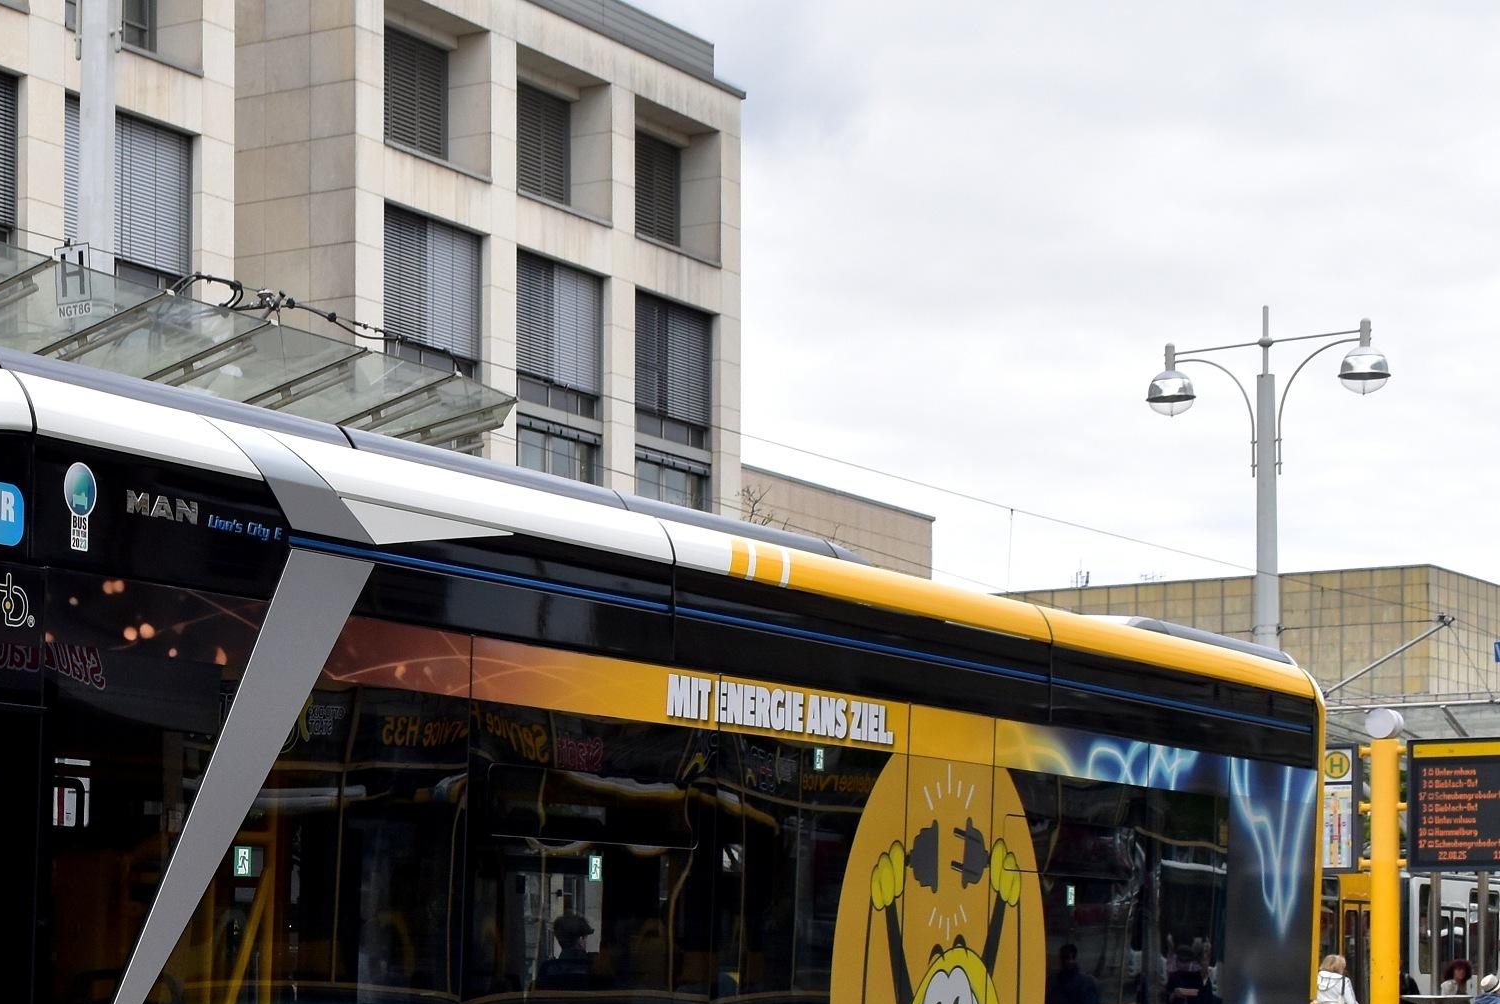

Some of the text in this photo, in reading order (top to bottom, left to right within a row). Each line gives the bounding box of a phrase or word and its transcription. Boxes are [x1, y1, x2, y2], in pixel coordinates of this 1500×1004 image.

[58, 303, 91, 318] NGT8G
[126, 489, 199, 525] MAN
[73, 515, 86, 530] BUS
[208, 514, 243, 533] Lion's
[246, 522, 271, 541] City
[666, 673, 894, 745] MIT ENERGIE ANS ZIEL.
